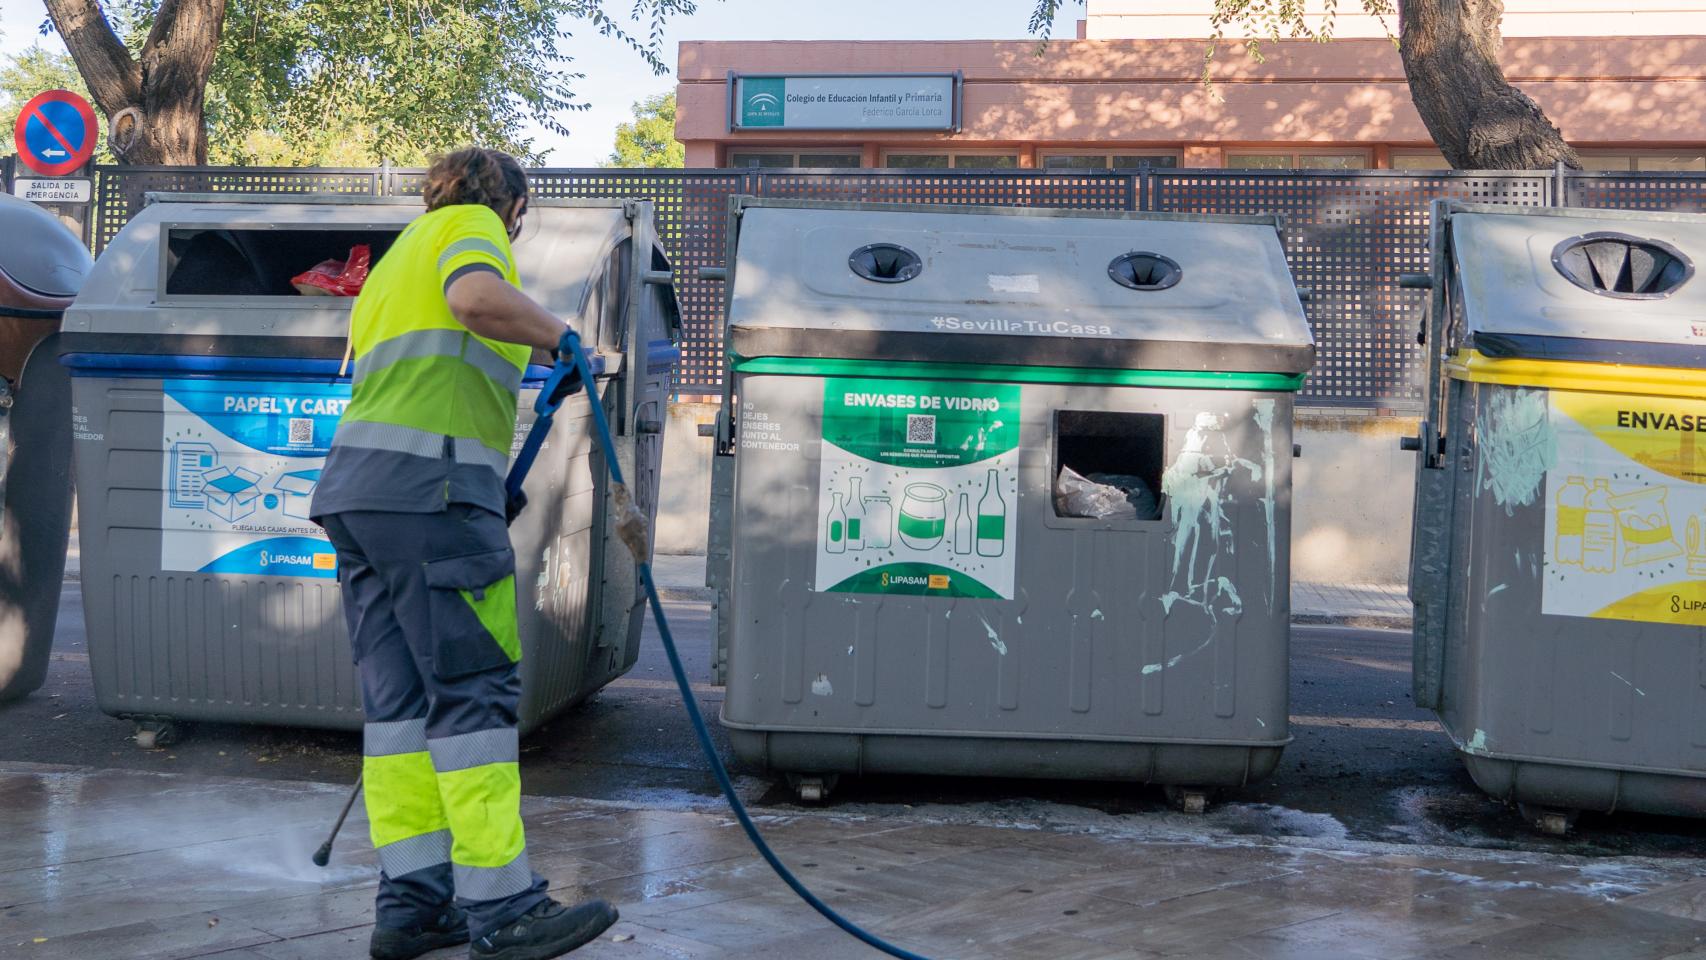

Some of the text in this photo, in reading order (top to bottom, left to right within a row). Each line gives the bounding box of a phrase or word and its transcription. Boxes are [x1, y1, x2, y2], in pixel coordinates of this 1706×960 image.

[786, 94, 815, 104] Colegio
[816, 94, 826, 102] de
[869, 94, 897, 103] Infantil
[897, 96, 903, 104] y
[905, 93, 942, 102] Primaria
[862, 107, 894, 116] Federico
[922, 107, 942, 116] Lorca
[25, 191, 79, 199] EMERGENCIA
[931, 316, 1112, 335] #SevillaTuCasa
[223, 396, 282, 413] PAPEL
[284, 398, 298, 414] Y
[743, 402, 754, 410] NO
[844, 392, 1000, 412] ENVASES DE VIDRIO
[742, 411, 768, 420] DEJES
[742, 421, 781, 430] ENSERES
[742, 431, 782, 440] JUNTO AL
[741, 440, 799, 451] CONTENEDOR
[270, 554, 311, 565] LIPASAM
[890, 576, 927, 585] LIPASAM
